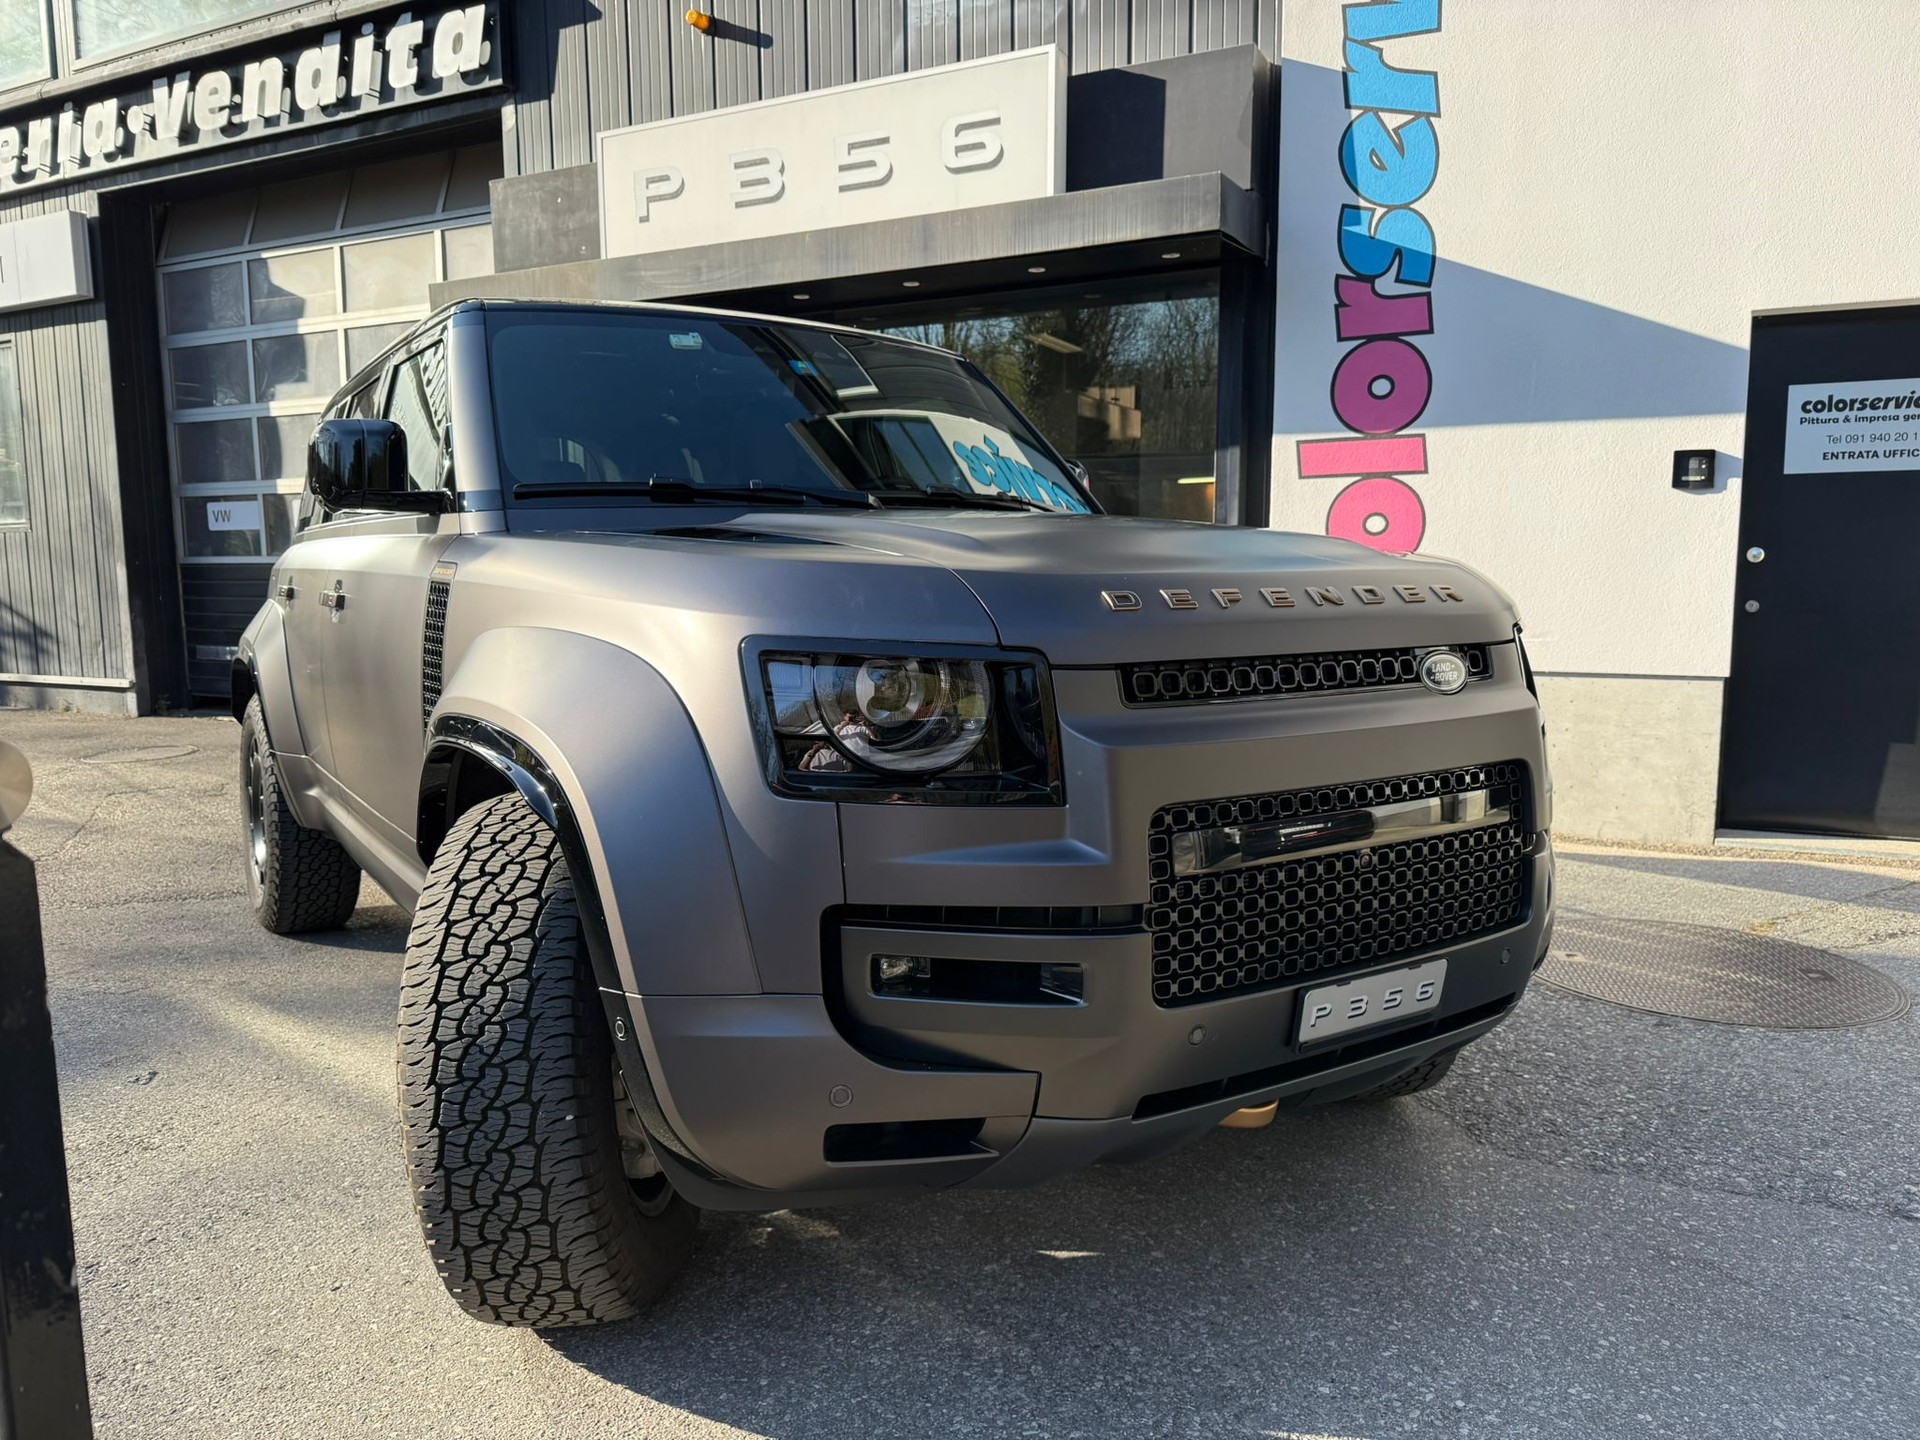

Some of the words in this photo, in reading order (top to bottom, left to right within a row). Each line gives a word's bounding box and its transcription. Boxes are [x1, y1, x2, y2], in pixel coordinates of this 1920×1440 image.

[1800, 416, 1840, 425] Pittura
[1842, 414, 1852, 423] &
[1854, 413, 1900, 424] impresa
[1826, 434, 1842, 444] Tel
[1845, 434, 1865, 444] 091
[1869, 432, 1891, 443] 940
[1894, 431, 1908, 442] 20
[1822, 450, 1879, 461] ENTRATA
[212, 509, 231, 523] VW
[1101, 583, 1464, 612] DEFENDER
